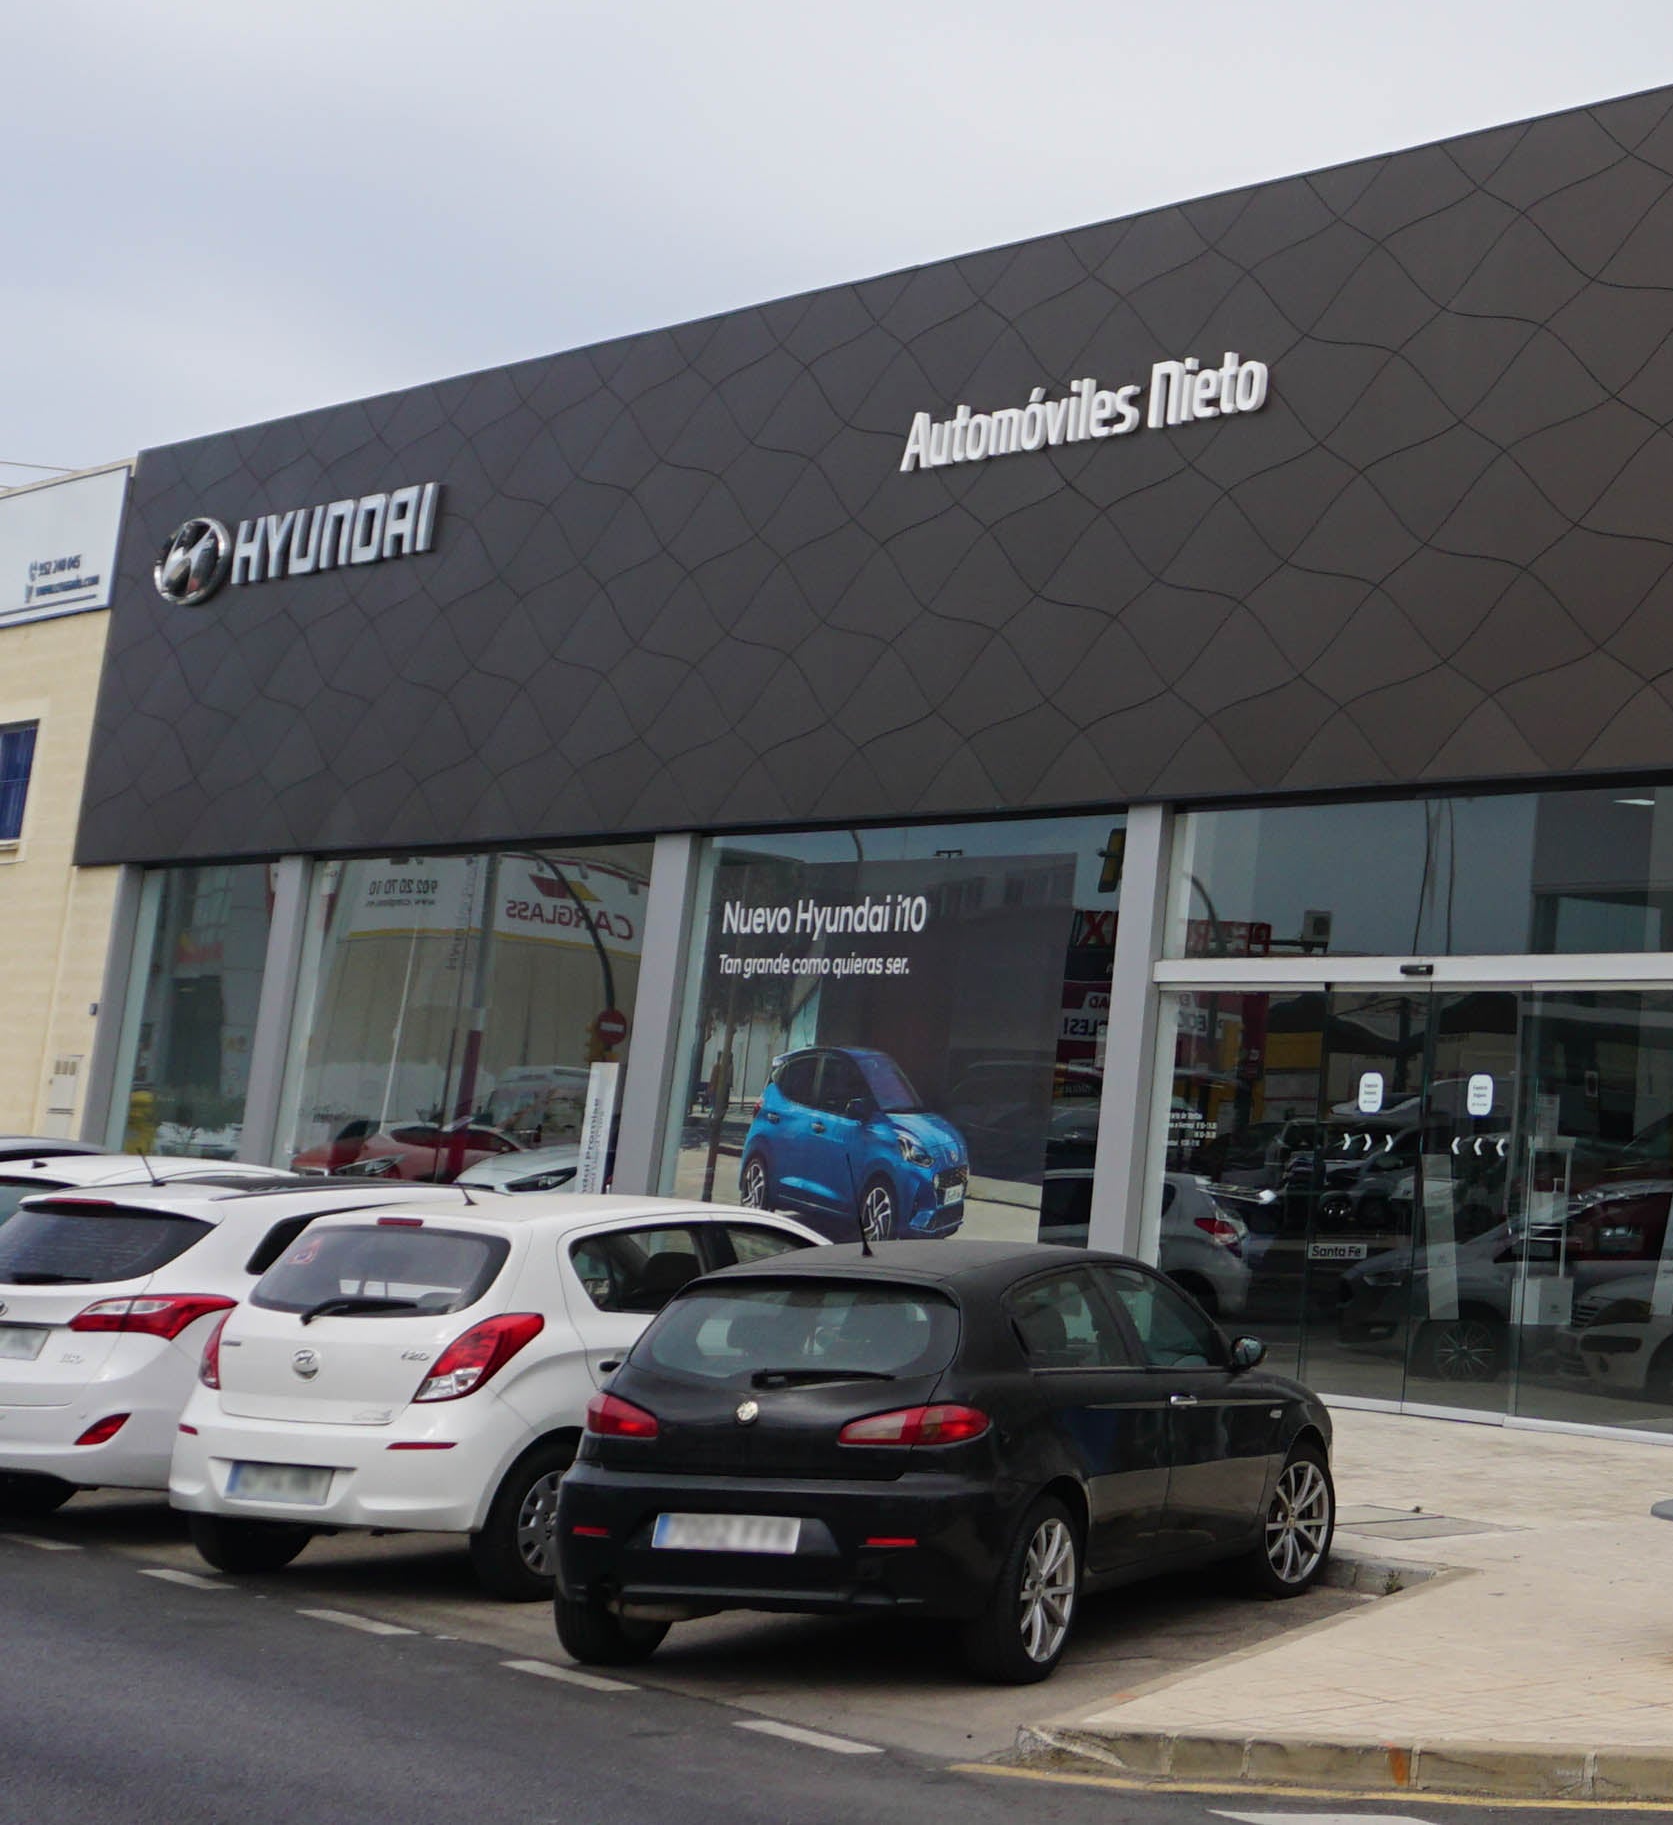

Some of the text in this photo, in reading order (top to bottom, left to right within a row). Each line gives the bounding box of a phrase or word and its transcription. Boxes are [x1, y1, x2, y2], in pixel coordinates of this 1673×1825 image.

[900, 352, 1268, 472] Automóviles Nieto
[231, 482, 440, 584] HYUNDAI
[722, 895, 927, 941] Nuevo Hyundai i10
[719, 952, 910, 979] Tan grande como quieras ser.
[1312, 1245, 1361, 1257] Santa Fe
